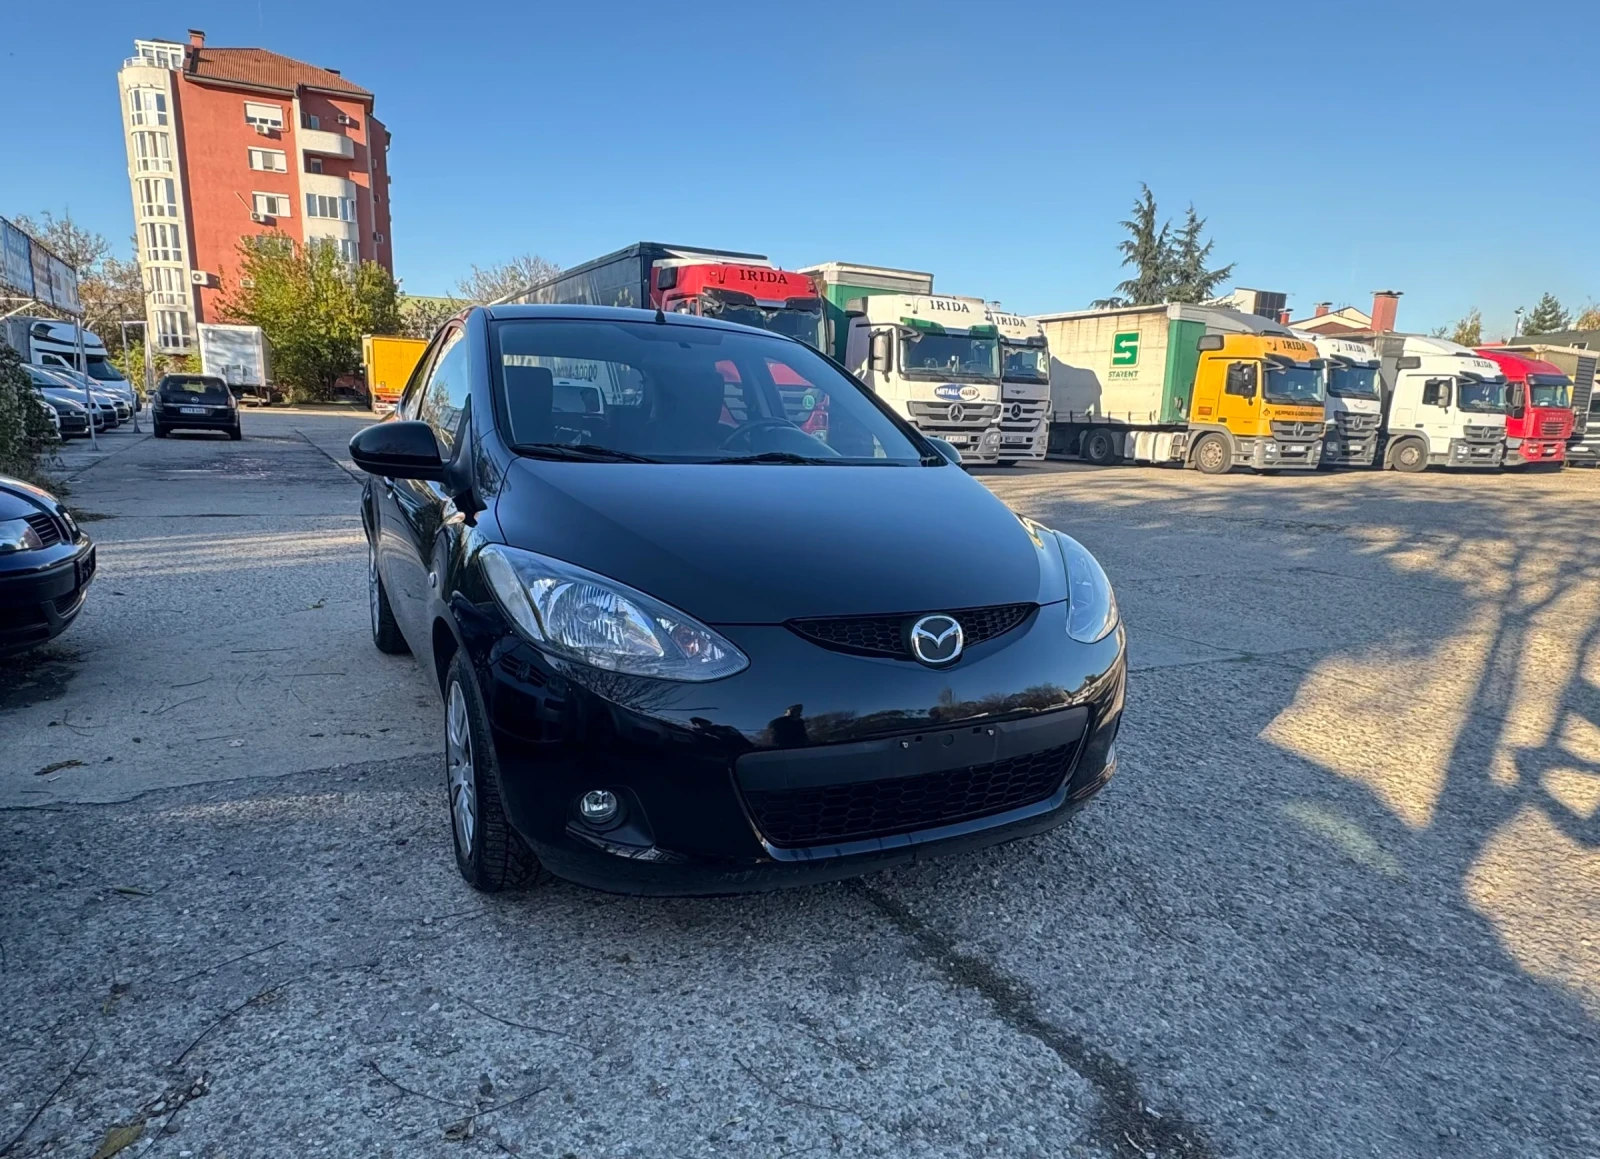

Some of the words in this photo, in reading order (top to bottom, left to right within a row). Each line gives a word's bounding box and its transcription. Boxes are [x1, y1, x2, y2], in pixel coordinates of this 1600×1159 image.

[739, 269, 788, 285] IRIDA
[929, 299, 970, 313] IRIDA
[995, 315, 1027, 328] IRIDA
[1281, 340, 1308, 351] IRIDA
[1344, 343, 1367, 354] IRIDA
[1472, 359, 1494, 369] IRIDA
[1108, 370, 1139, 378] STARENT
